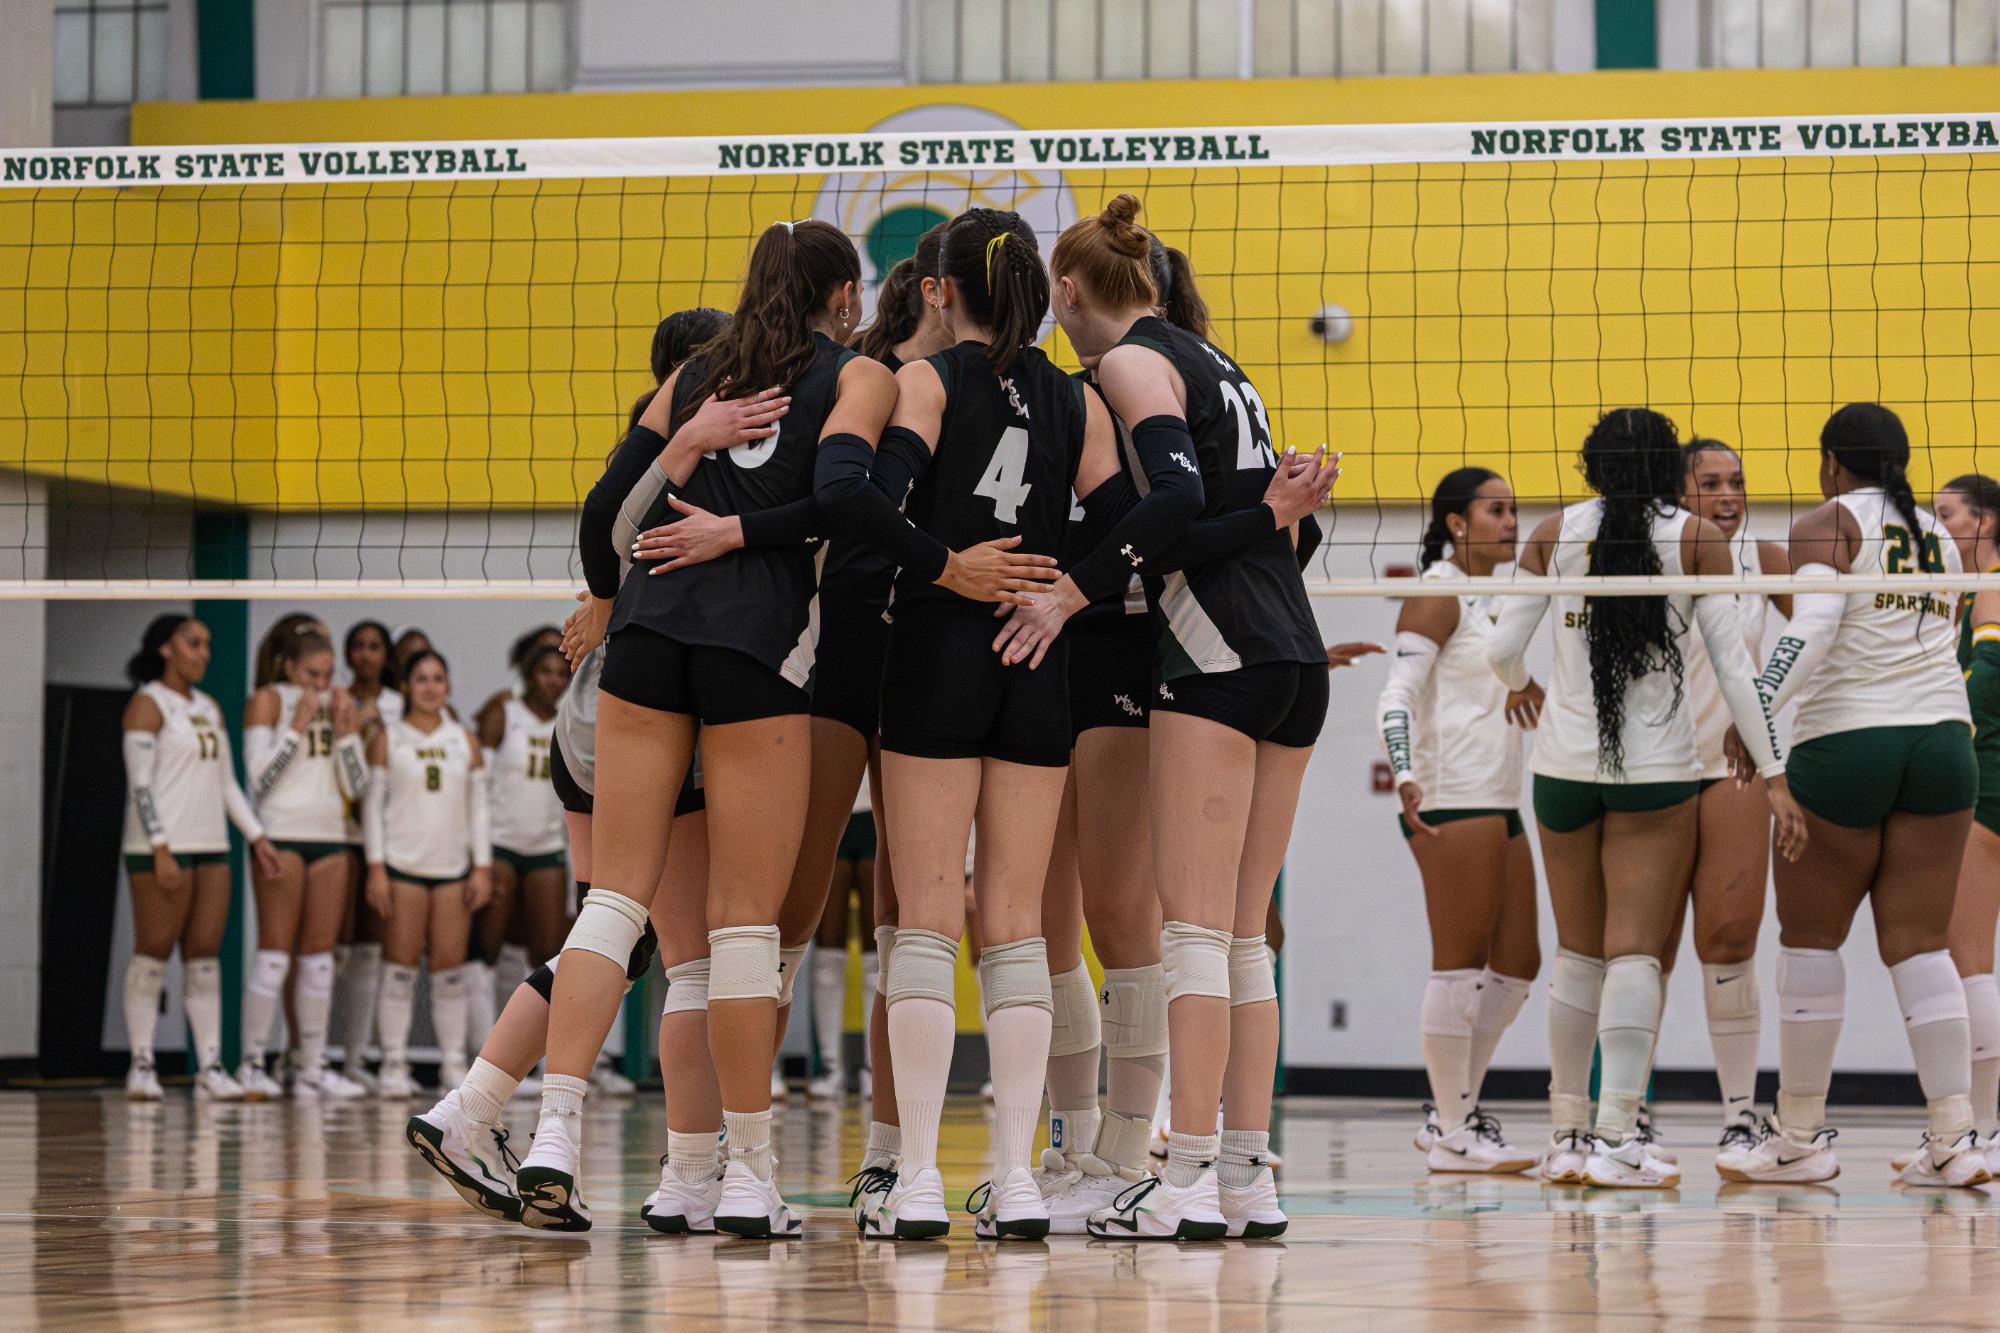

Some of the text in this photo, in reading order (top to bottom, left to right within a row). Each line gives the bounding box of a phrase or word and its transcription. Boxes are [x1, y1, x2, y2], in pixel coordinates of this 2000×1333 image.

[718, 135, 1269, 169] NORFOLK STATE VOLLEYBALL
[1472, 120, 2000, 155] NORFOLK STATE VOLLEYBA
[3, 148, 527, 181] NORFOLK STATE VOLLEYBALL
[998, 375, 1031, 420] W&M
[1219, 379, 1278, 471] 23
[972, 425, 1033, 525] 4
[1168, 451, 1200, 476] W&M
[1873, 591, 1951, 620] SPARTANS
[1113, 693, 1143, 717] W&M
[1159, 681, 1175, 701] &M
